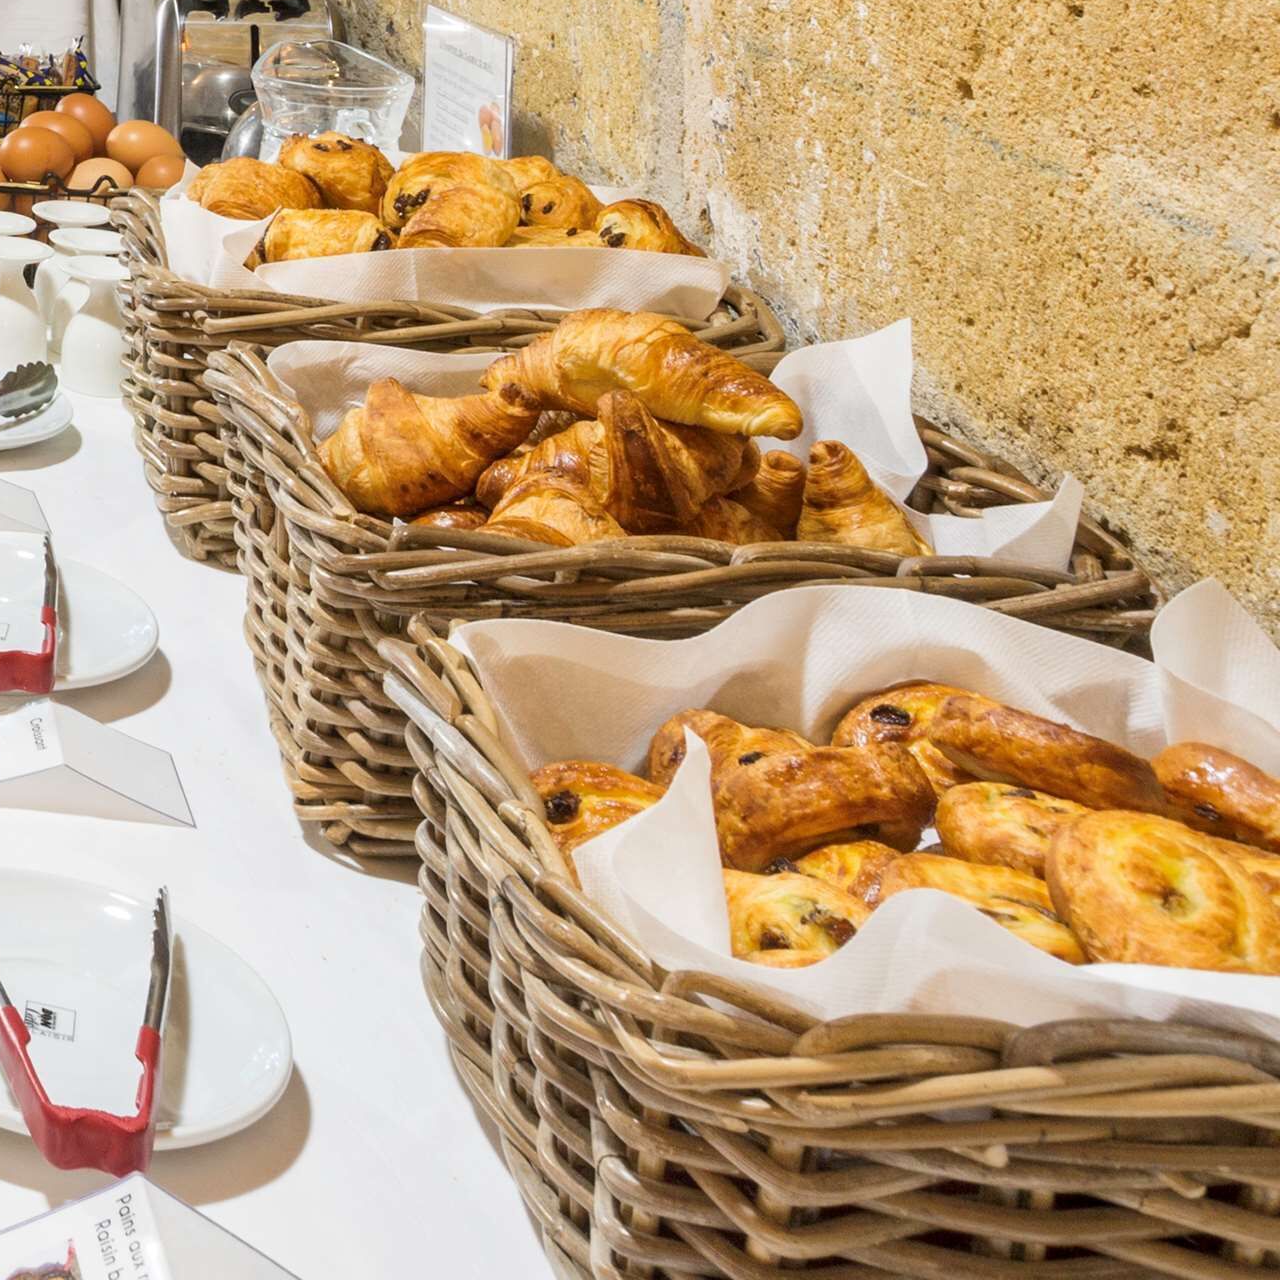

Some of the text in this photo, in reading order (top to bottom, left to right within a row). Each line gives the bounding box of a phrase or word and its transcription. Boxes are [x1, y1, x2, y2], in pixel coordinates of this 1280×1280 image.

[94, 1218, 117, 1266] Raisin
[115, 1193, 136, 1237] Pains
[128, 1240, 144, 1271] aux
